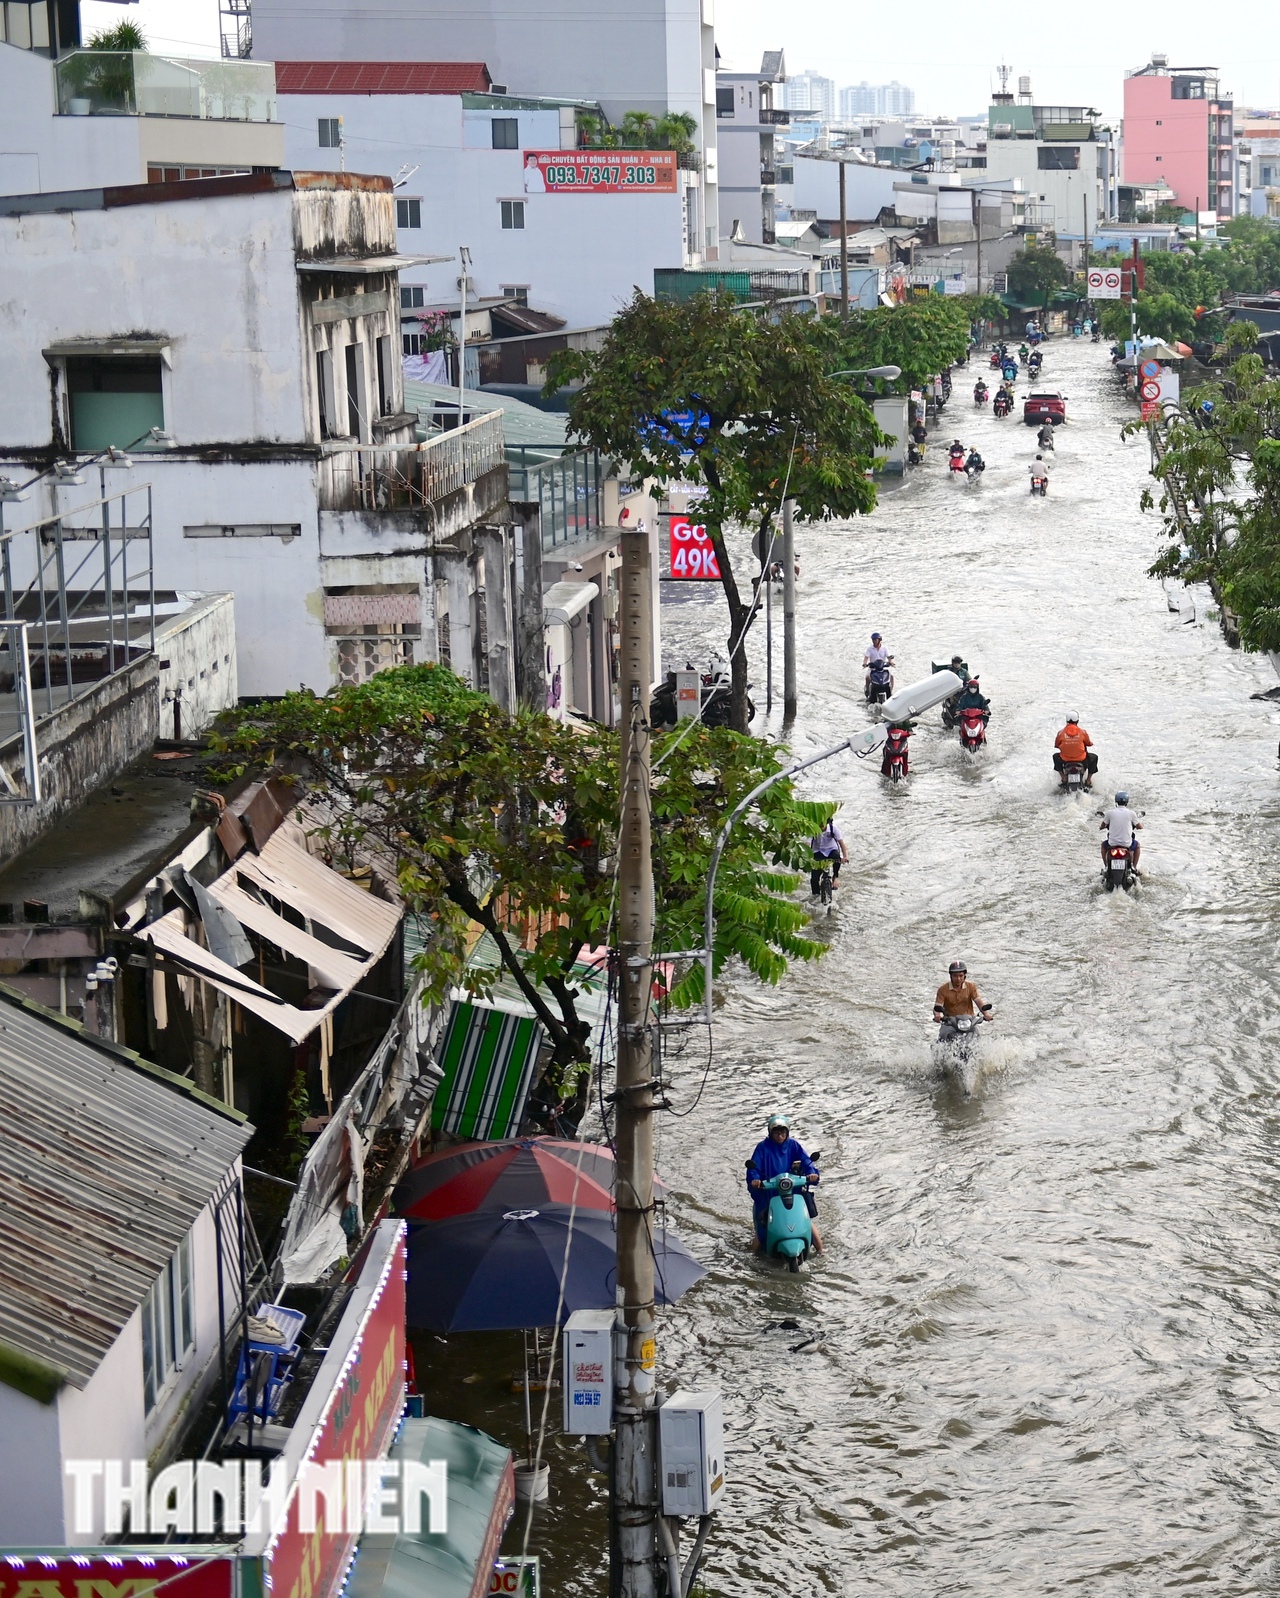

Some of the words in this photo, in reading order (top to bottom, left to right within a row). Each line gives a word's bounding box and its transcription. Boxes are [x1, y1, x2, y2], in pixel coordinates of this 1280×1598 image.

[551, 154, 575, 164] CHUYÊN
[576, 153, 588, 164] BẤT
[589, 154, 606, 164] ĐỘNG
[607, 153, 620, 164] SẢN
[621, 154, 639, 165] QUẬN
[640, 156, 644, 164] 7
[650, 154, 663, 164] NHÀ
[546, 166, 656, 185] 093.7347.303
[673, 547, 719, 576] 49K
[363, 1326, 396, 1449] NAM
